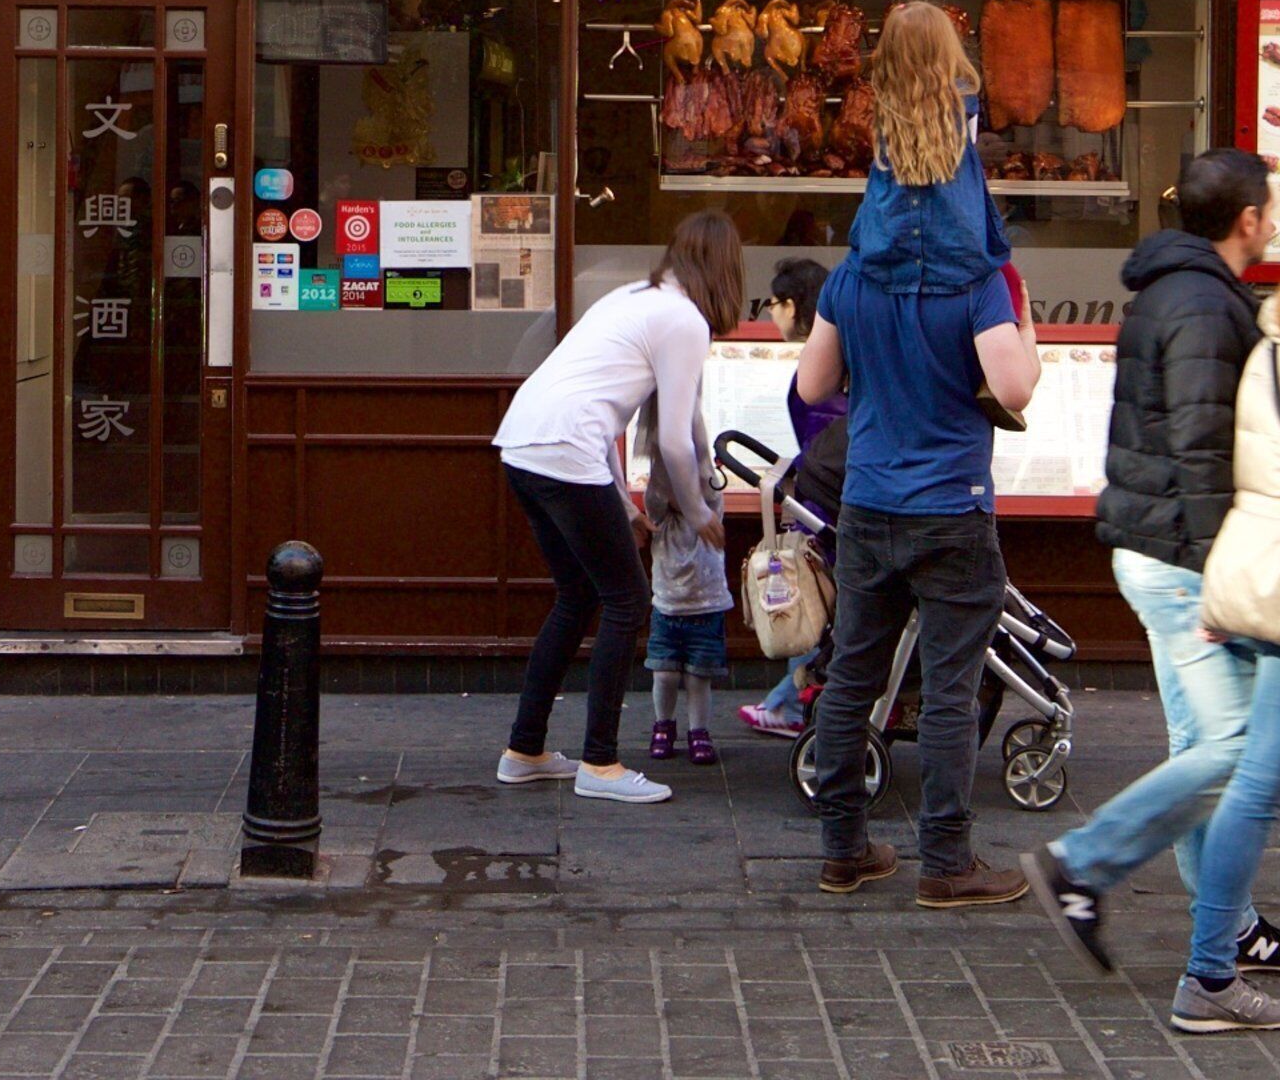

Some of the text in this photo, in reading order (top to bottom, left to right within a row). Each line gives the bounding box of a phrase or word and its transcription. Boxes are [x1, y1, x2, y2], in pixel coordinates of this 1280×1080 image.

[341, 205, 375, 214] Harden's
[346, 243, 367, 252] 2015
[73, 94, 139, 443] 文興酒家
[342, 281, 380, 291] ZAGAT
[301, 288, 337, 300] 2012
[342, 291, 366, 300] 2014
[1246, 936, 1280, 962] N
